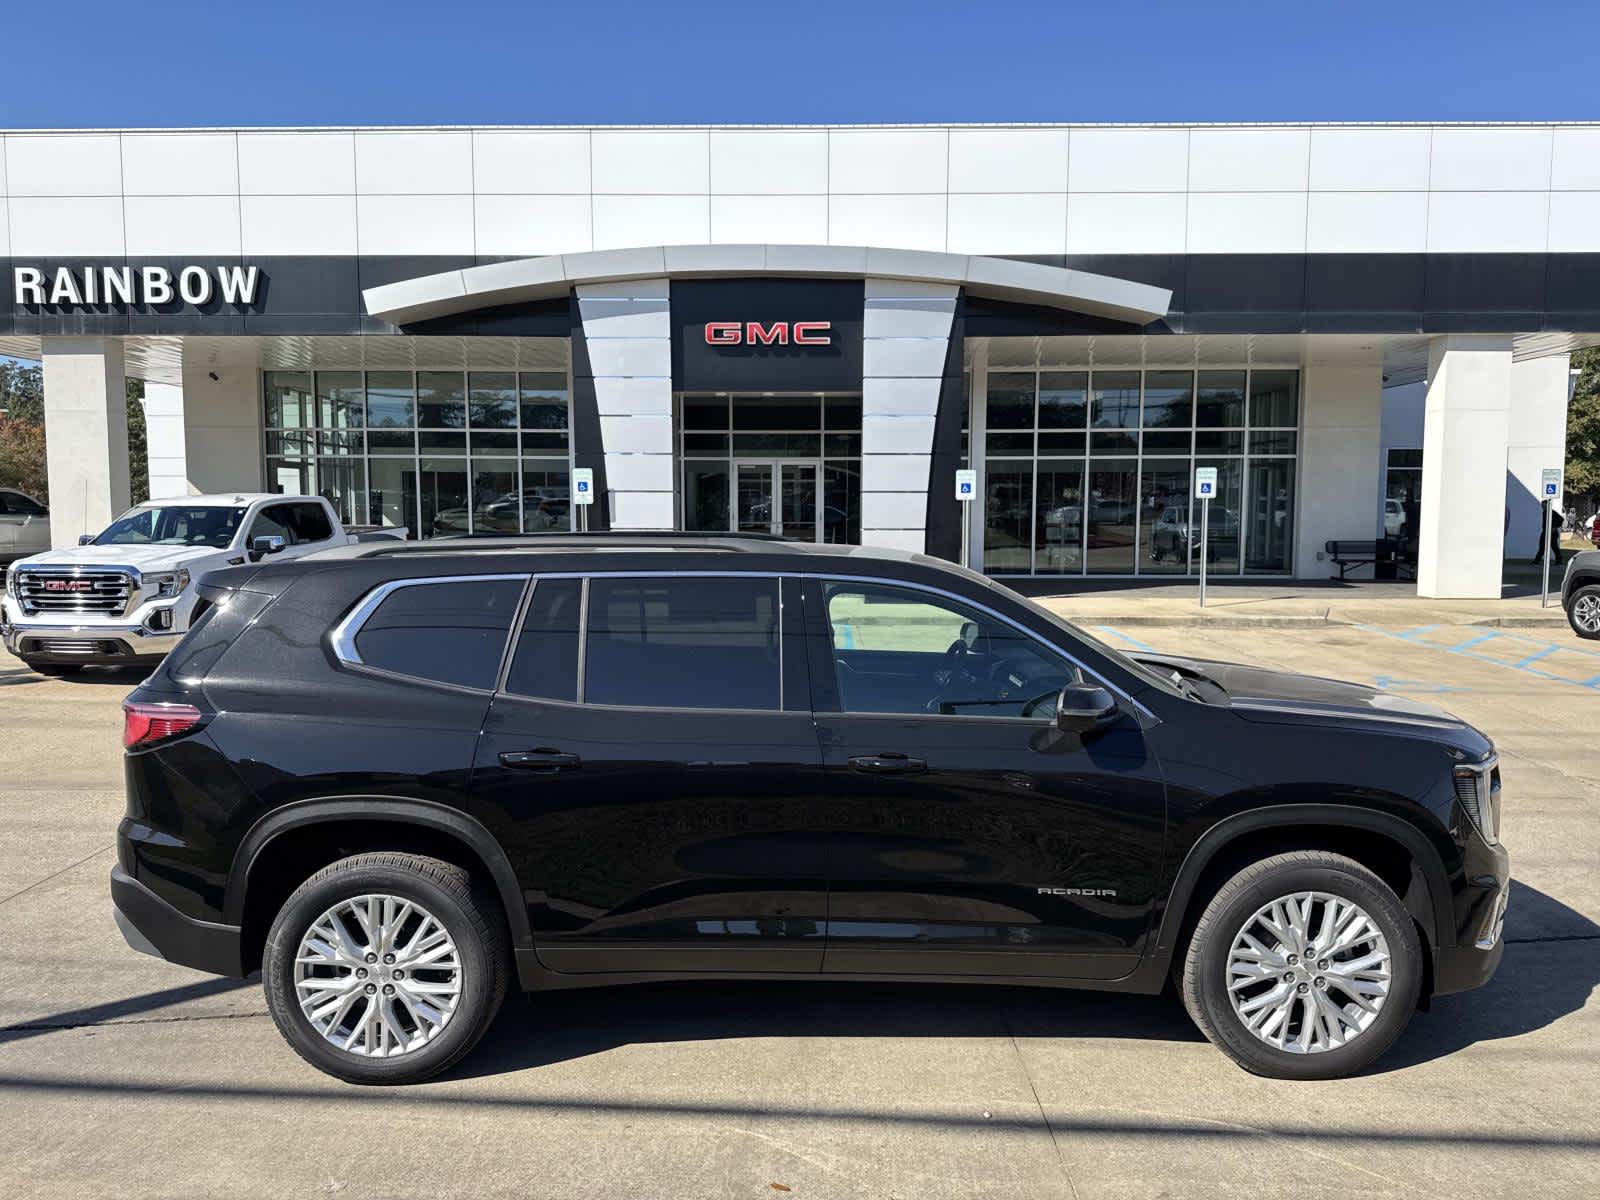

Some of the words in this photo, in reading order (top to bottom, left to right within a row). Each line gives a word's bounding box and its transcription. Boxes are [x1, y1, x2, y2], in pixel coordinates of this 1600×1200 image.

[14, 265, 258, 305] RAINBOW
[704, 322, 831, 345] GMC
[45, 580, 92, 591] GMC
[1037, 887, 1117, 897] ACADIA
